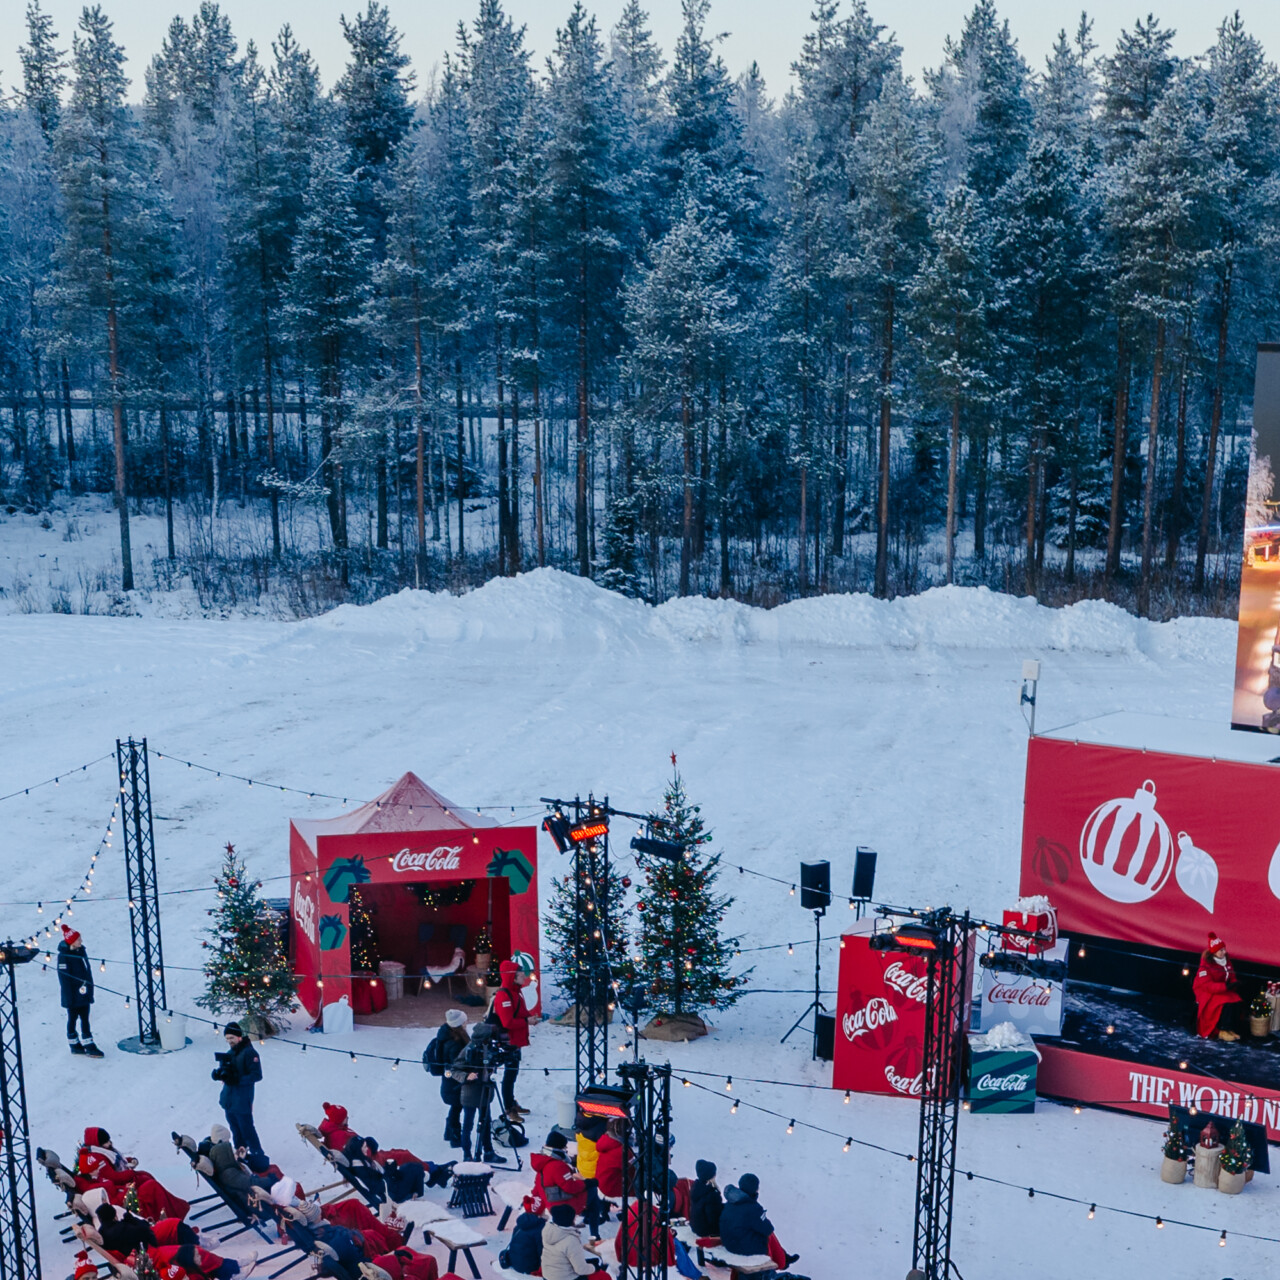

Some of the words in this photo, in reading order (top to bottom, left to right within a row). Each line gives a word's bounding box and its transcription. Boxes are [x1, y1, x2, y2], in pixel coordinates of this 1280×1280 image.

[392, 845, 464, 873] Coca-Cola
[987, 983, 1052, 1006] Coca-Cola
[841, 996, 899, 1042] Coca-Cola
[976, 1073, 1030, 1092] Coca-Cola
[1128, 1071, 1175, 1107] THE
[1177, 1081, 1259, 1125] WORLD
